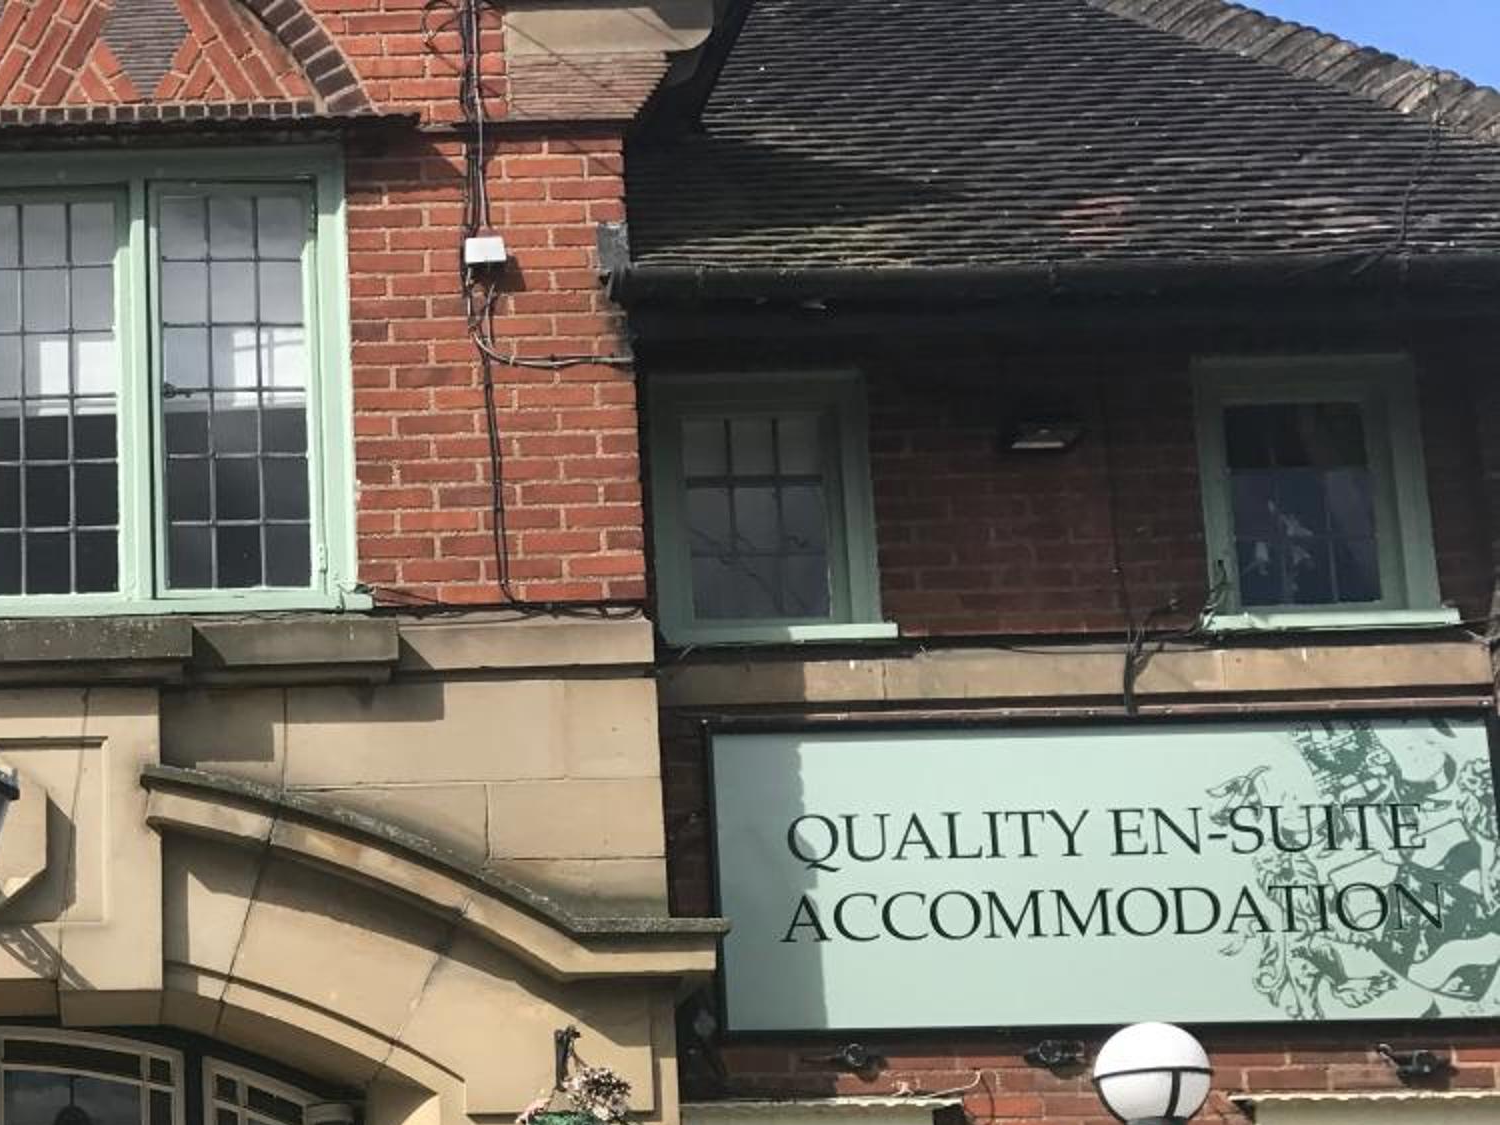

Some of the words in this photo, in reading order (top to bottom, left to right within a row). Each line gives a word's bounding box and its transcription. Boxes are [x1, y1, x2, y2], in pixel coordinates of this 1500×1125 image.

[787, 808, 1089, 873] QUALITY
[1110, 803, 1428, 856] EN-SUITE
[780, 881, 1447, 943] ACCOMMODATION
